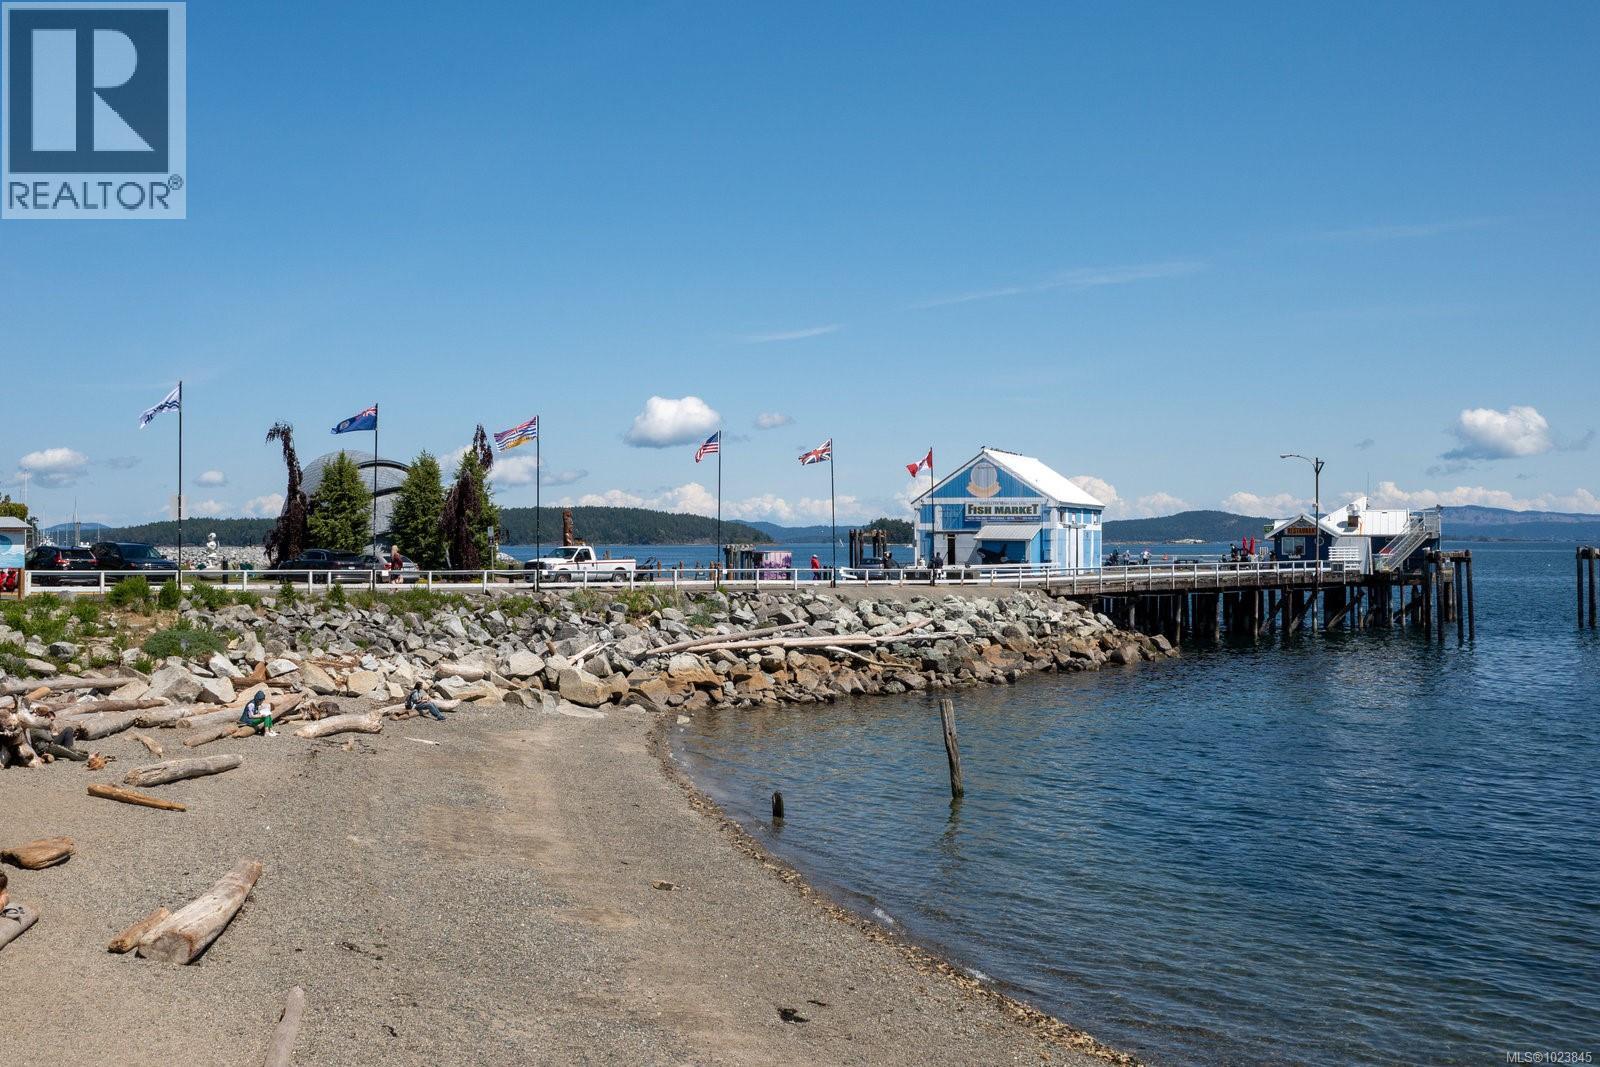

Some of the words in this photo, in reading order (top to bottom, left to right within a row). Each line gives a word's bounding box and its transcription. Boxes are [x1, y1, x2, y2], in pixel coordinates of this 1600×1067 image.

[967, 503, 992, 515] FISH
[994, 503, 1039, 515] MARKET
[1287, 527, 1318, 535] RESTAURAN
